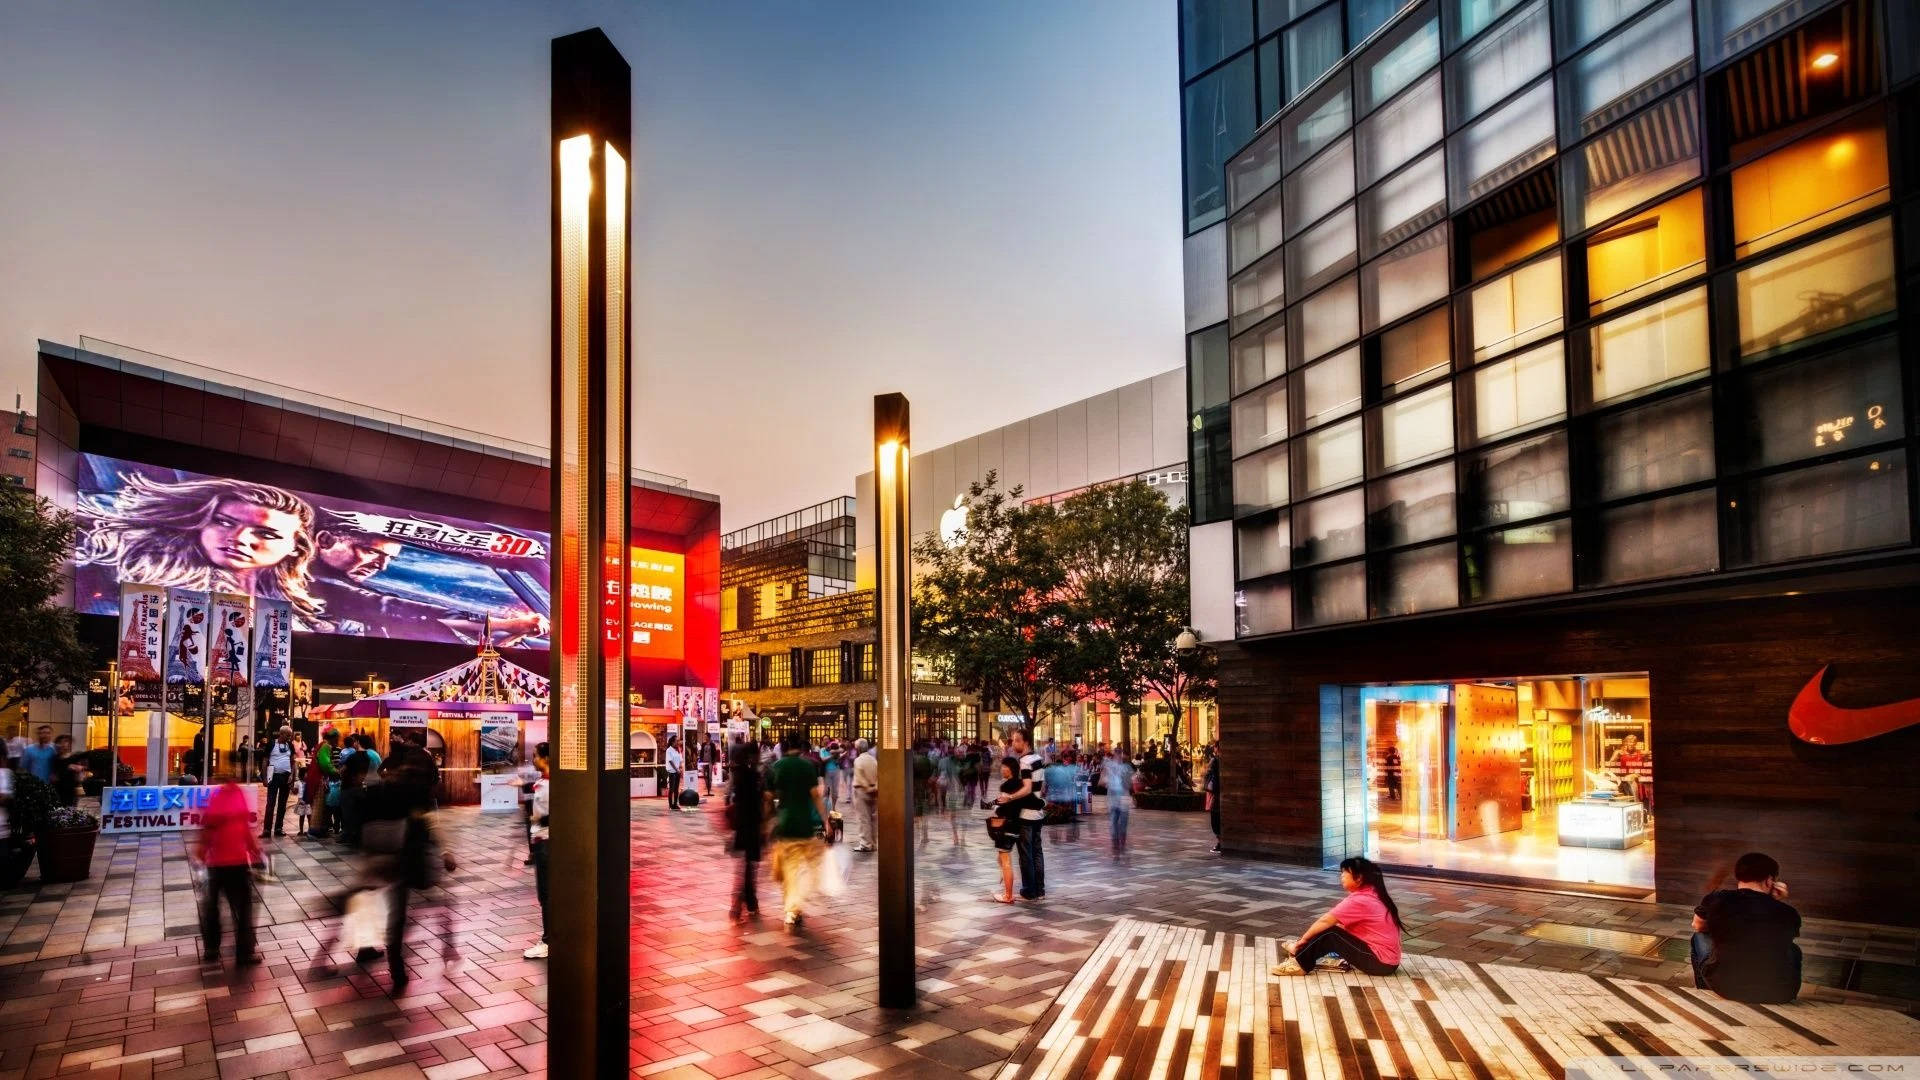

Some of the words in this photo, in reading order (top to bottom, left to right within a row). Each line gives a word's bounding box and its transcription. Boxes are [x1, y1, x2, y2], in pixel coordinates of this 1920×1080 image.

[147, 594, 160, 660] 法国文化节
[278, 609, 289, 669] 法国文化节
[437, 711, 464, 719] FESTIVAL
[465, 711, 482, 719] FRAN
[110, 787, 212, 813] 法国文化
[102, 812, 176, 829] FESTIVAL
